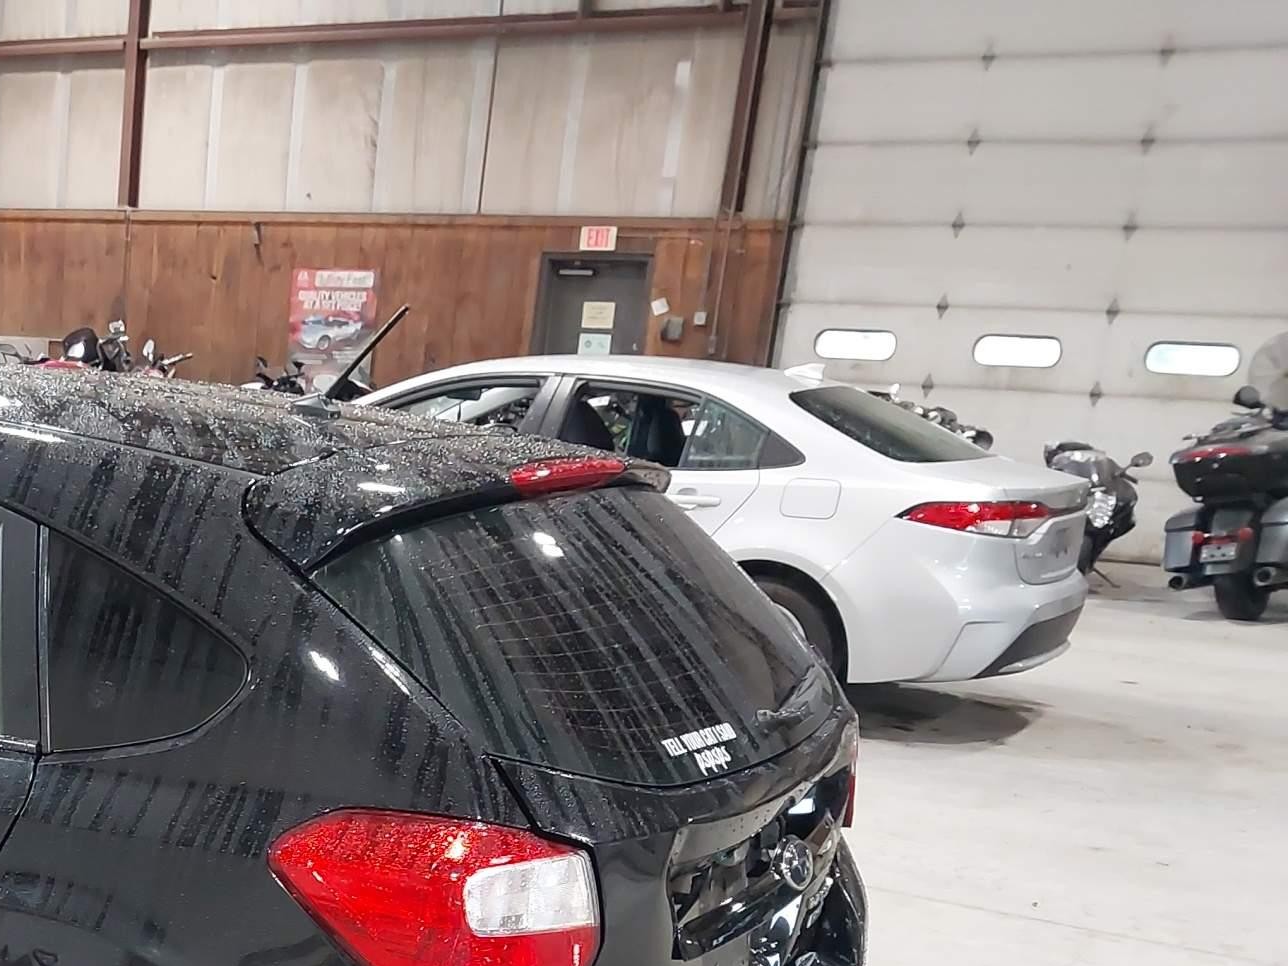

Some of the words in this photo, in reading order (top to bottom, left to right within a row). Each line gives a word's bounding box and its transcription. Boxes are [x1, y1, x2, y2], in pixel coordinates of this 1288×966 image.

[587, 228, 611, 248] EXIT
[661, 738, 688, 757] TELL
[679, 730, 707, 751] YOUR
[699, 727, 719, 746] CAT
[715, 722, 737, 741] SAID
